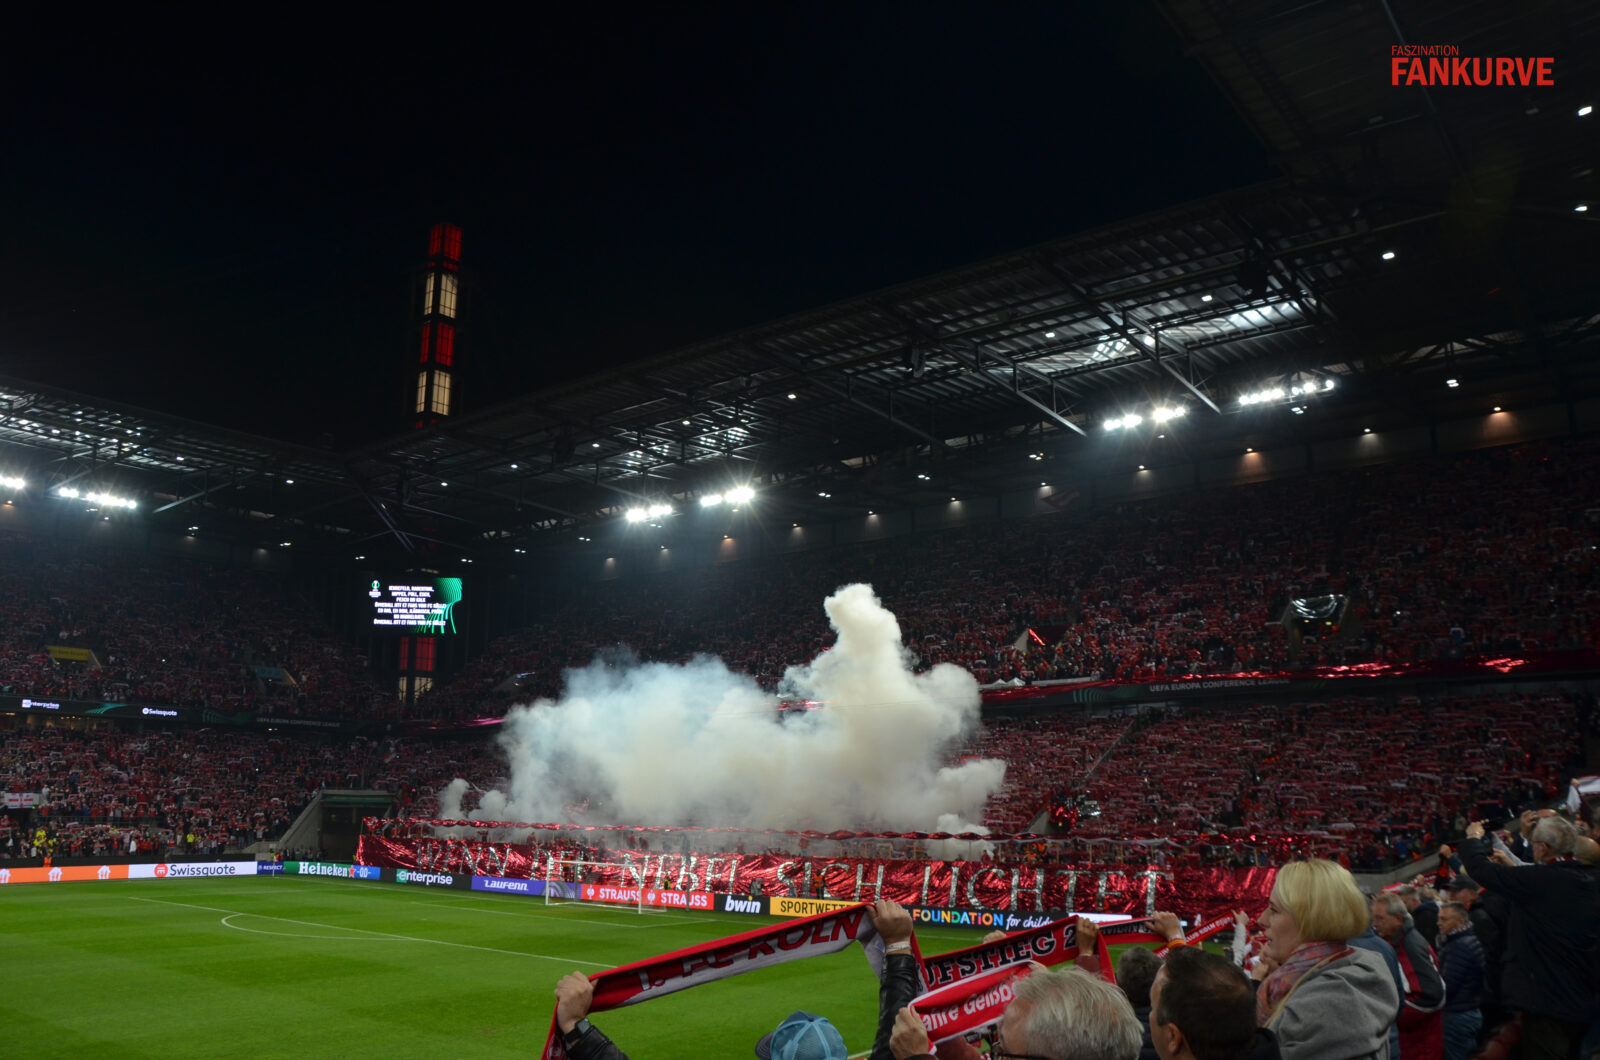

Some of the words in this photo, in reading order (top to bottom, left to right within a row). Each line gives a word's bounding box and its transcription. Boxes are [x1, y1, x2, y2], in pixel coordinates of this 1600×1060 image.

[1149, 683, 1170, 692] UEFA
[1170, 681, 1201, 691] EUROPA
[1202, 679, 1256, 689] CONFERENCE
[169, 863, 236, 879] Swissquote
[298, 861, 348, 877] Heineken
[398, 870, 453, 886] enterprise
[599, 887, 641, 901] STRAUSS
[660, 892, 708, 907] STRAUSS
[725, 895, 761, 914] bwin
[913, 909, 1004, 926] FOUNDATION
[1005, 914, 1022, 931] for
[925, 931, 1058, 988] UFSTIEG
[921, 1004, 960, 1033] ahre
